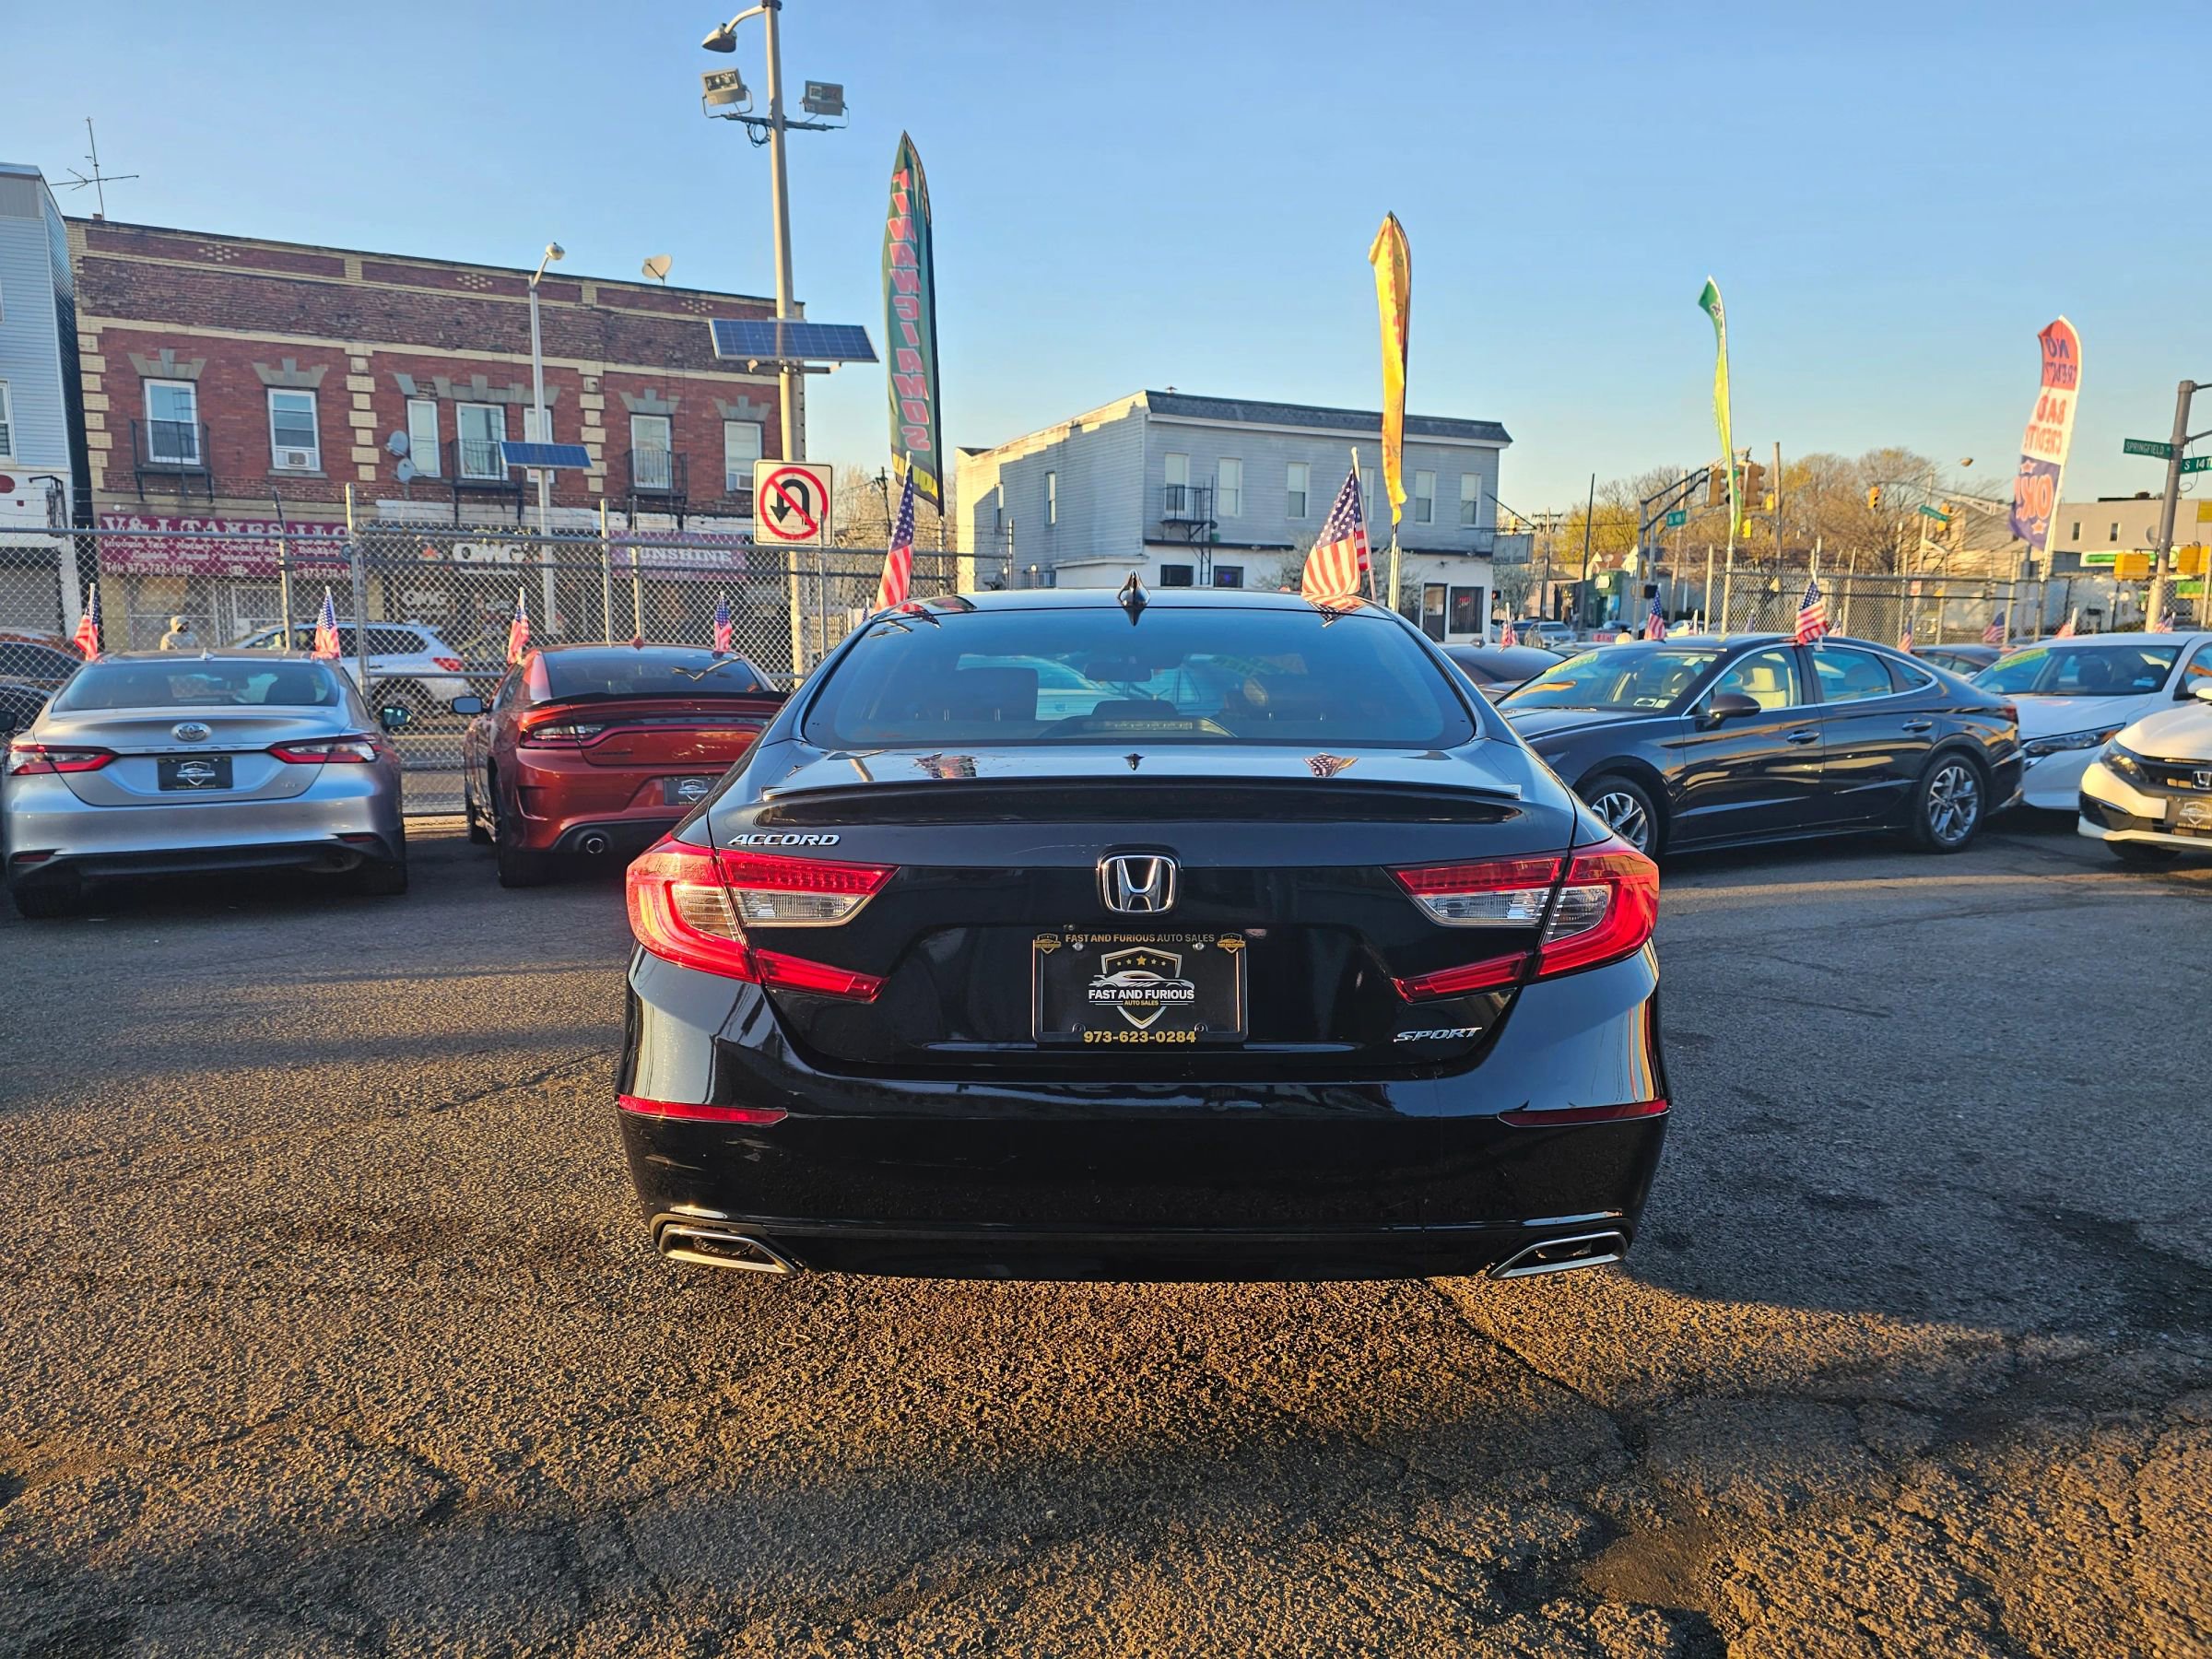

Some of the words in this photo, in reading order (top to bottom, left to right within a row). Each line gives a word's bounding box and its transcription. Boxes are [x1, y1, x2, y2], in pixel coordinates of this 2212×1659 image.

[2125, 441, 2165, 455] SPRINGFIELD
[727, 833, 841, 846] ACCORD
[1065, 934, 1089, 943] FAST
[1090, 934, 1112, 943] AND
[1113, 934, 1155, 943] FURIOUS
[1157, 934, 1182, 943] AUTO
[1184, 934, 1215, 943] SALES
[1088, 989, 1116, 1000] FAST
[1118, 989, 1143, 1000] AND
[1145, 989, 1194, 1000] FURIOUS
[1083, 1030, 1196, 1043] 973-623-0284
[1393, 1027, 1483, 1042] SPORT
